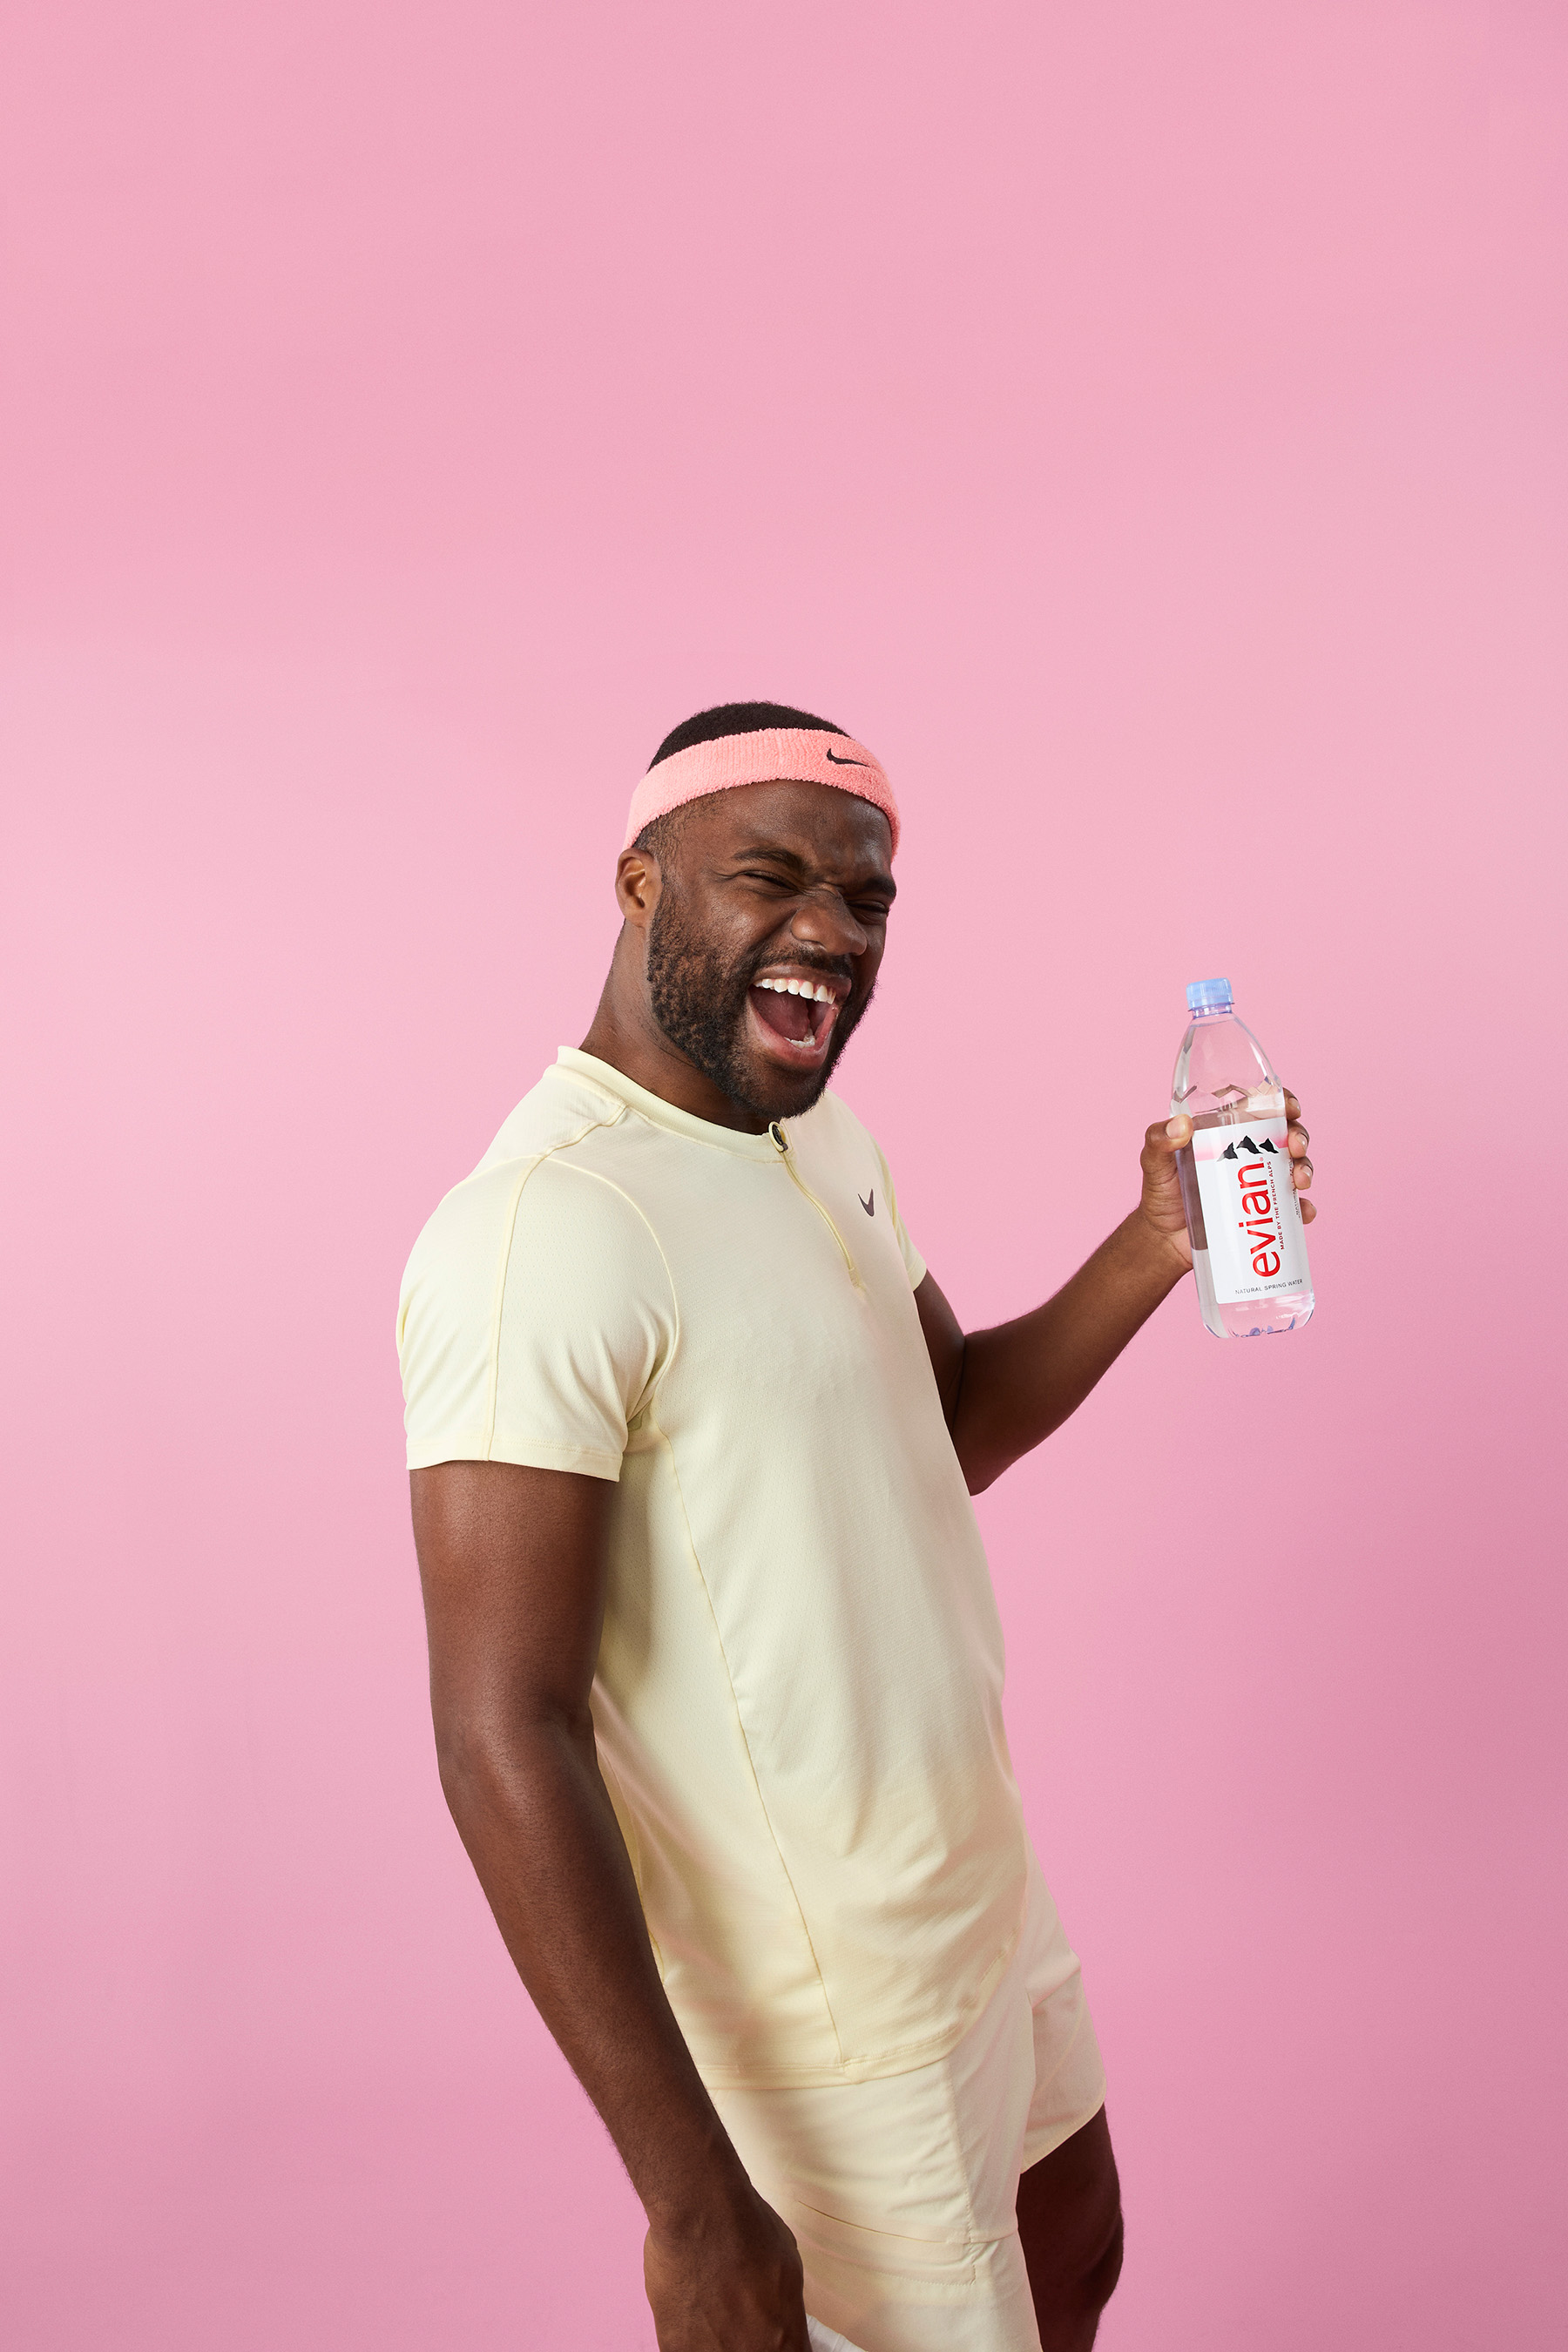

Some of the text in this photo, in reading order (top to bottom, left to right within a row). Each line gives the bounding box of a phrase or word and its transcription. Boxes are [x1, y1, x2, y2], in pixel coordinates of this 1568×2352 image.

[1276, 1221, 1281, 1230] BY
[1264, 1281, 1287, 1291] SPRING
[1288, 1278, 1303, 1287] WATER
